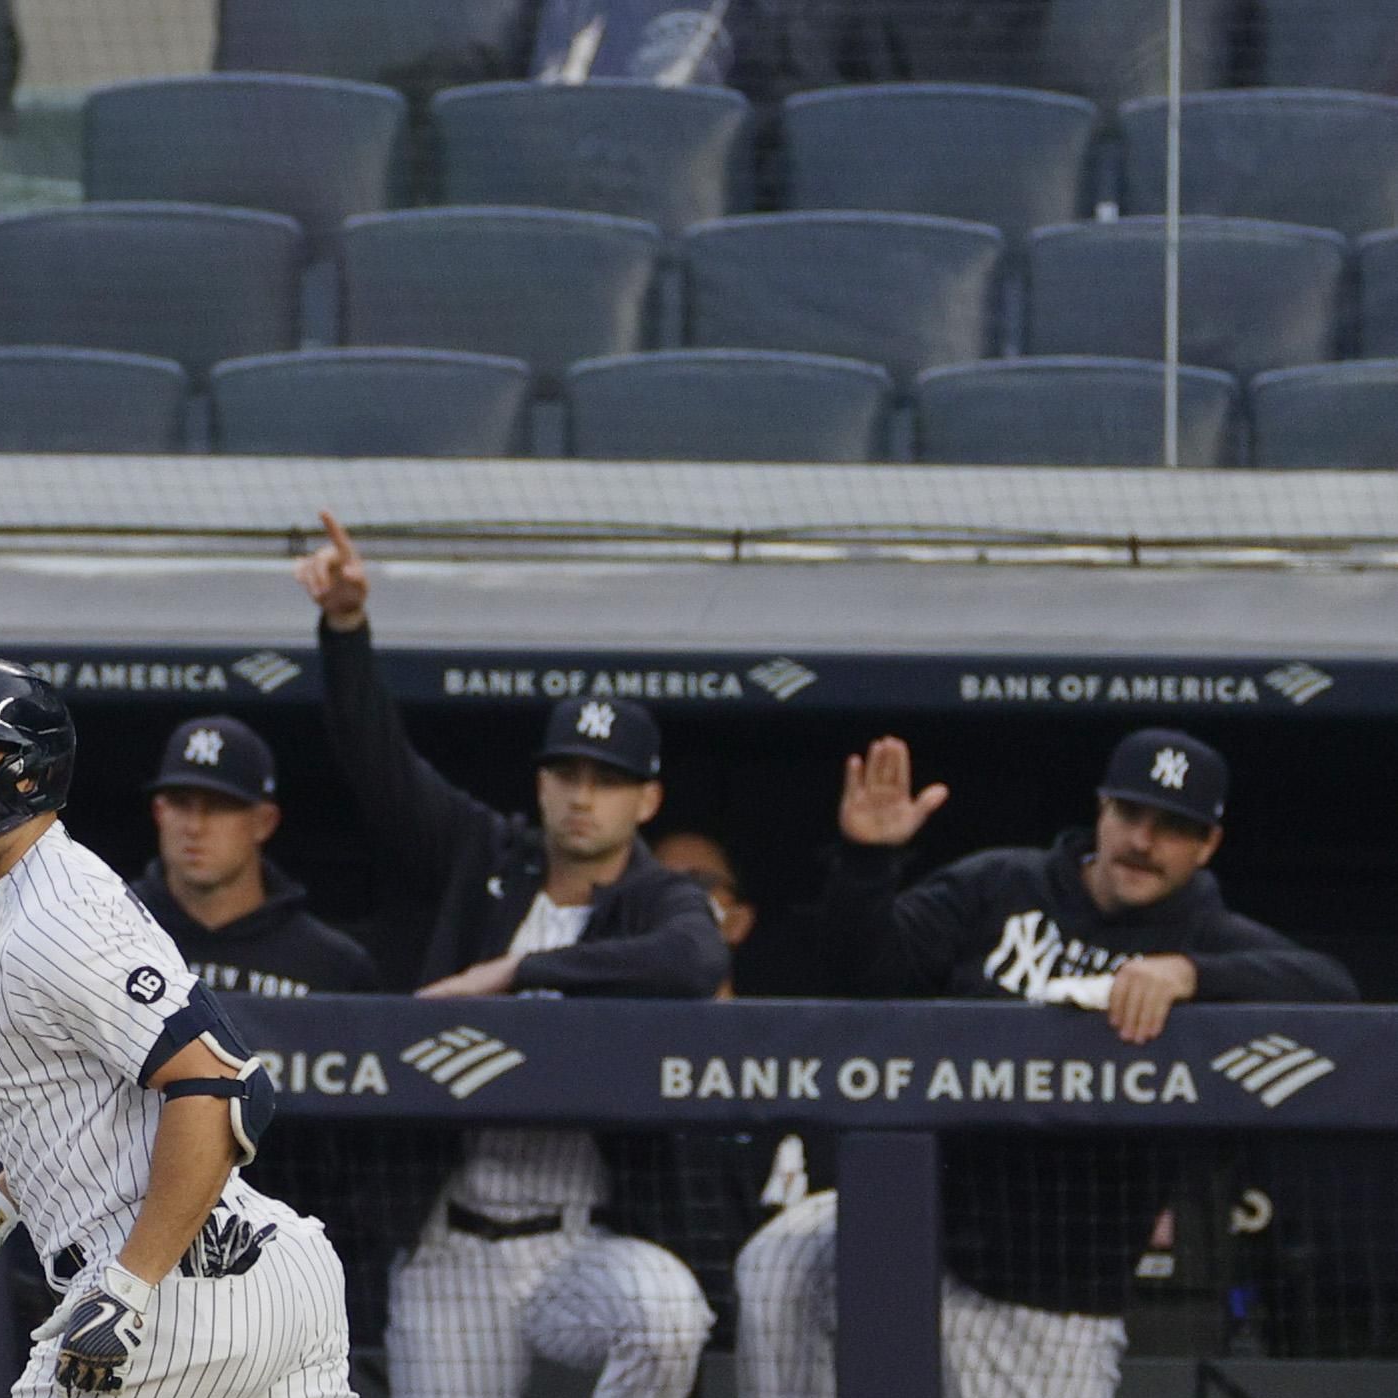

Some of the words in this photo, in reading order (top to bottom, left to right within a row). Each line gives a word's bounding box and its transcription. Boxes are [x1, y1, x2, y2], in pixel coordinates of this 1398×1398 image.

[75, 662, 228, 692] AMERICA
[443, 668, 535, 697] BANK
[542, 669, 586, 697] OF
[592, 670, 743, 699] AMERICA
[959, 673, 1051, 701] BANK
[1058, 674, 1101, 702] OF
[1107, 675, 1259, 703] AMERICA
[183, 727, 225, 766] NY
[1150, 747, 1190, 790] NY
[983, 909, 1065, 1003] NY
[131, 969, 164, 1001] 16
[257, 1047, 390, 1096] RICA
[661, 1056, 822, 1100] BANK
[837, 1057, 914, 1101] OF
[927, 1059, 1199, 1103] AMERICA
